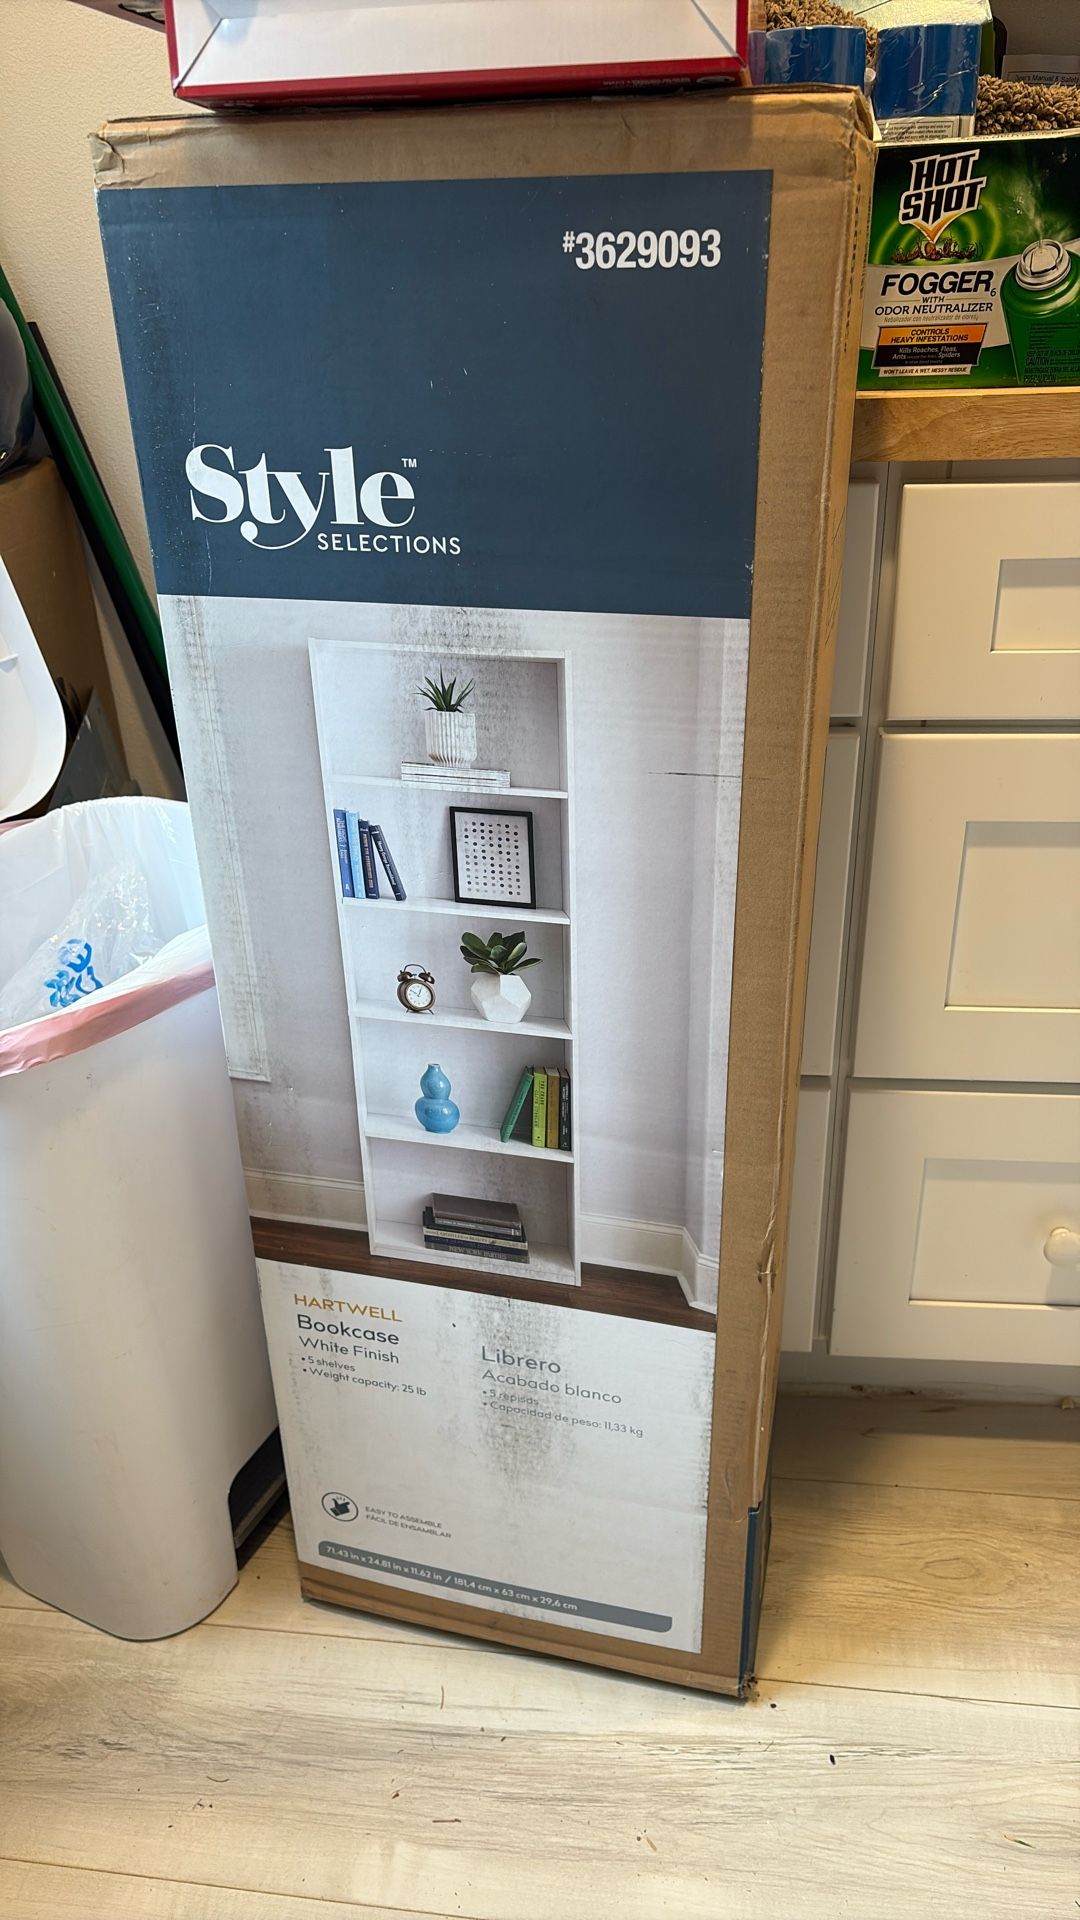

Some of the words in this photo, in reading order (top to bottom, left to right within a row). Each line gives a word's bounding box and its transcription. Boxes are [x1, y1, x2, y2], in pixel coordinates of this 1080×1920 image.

[911, 151, 979, 191] HOT
[901, 179, 985, 226] SHOT
[561, 229, 722, 270] #3629093
[881, 270, 994, 296] FOGGER
[875, 305, 910, 316] ODOR
[912, 302, 993, 315] NEUTRALIZER
[922, 296, 946, 304] WITH
[890, 335, 915, 344] HEAVY
[916, 334, 969, 343] INFESTATIONS
[911, 327, 950, 336] CONTROLS
[899, 346, 912, 354] Kills
[938, 351, 961, 359] Spiders
[184, 443, 416, 550] Style
[317, 532, 461, 555] SELECTIONS
[293, 1293, 402, 1323] HARTWELL
[297, 1313, 400, 1345] Bookcase
[299, 1335, 349, 1355] White
[353, 1345, 399, 1364] Finish
[481, 1345, 561, 1374] Librero
[307, 1355, 314, 1364] 5
[316, 1358, 356, 1372] shelves
[309, 1367, 350, 1383] Weight
[352, 1375, 400, 1392] capacity:
[402, 1383, 414, 1394] 25
[416, 1386, 427, 1396] lb
[481, 1369, 560, 1393] Acabado
[565, 1383, 622, 1404] blanco
[489, 1389, 496, 1398] 5
[490, 1400, 552, 1419] Capacidad
[554, 1412, 569, 1423] de
[571, 1417, 602, 1429] peso:
[629, 1426, 643, 1438] kg
[365, 1505, 388, 1517] EASY
[388, 1511, 399, 1519] TO
[400, 1513, 443, 1529] ASSEMBLE
[388, 1519, 399, 1527] DE
[400, 1522, 452, 1539] ENSAMBLAR
[326, 1545, 349, 1558] 71.43
[350, 1552, 359, 1561] in
[368, 1556, 392, 1569] 24.81
[393, 1563, 402, 1572] in
[410, 1567, 432, 1579] 11.62
[433, 1572, 442, 1581] in
[477, 1583, 492, 1593] cm
[501, 1587, 514, 1597] 63
[515, 1592, 530, 1601] cm
[562, 1601, 578, 1611] cm
